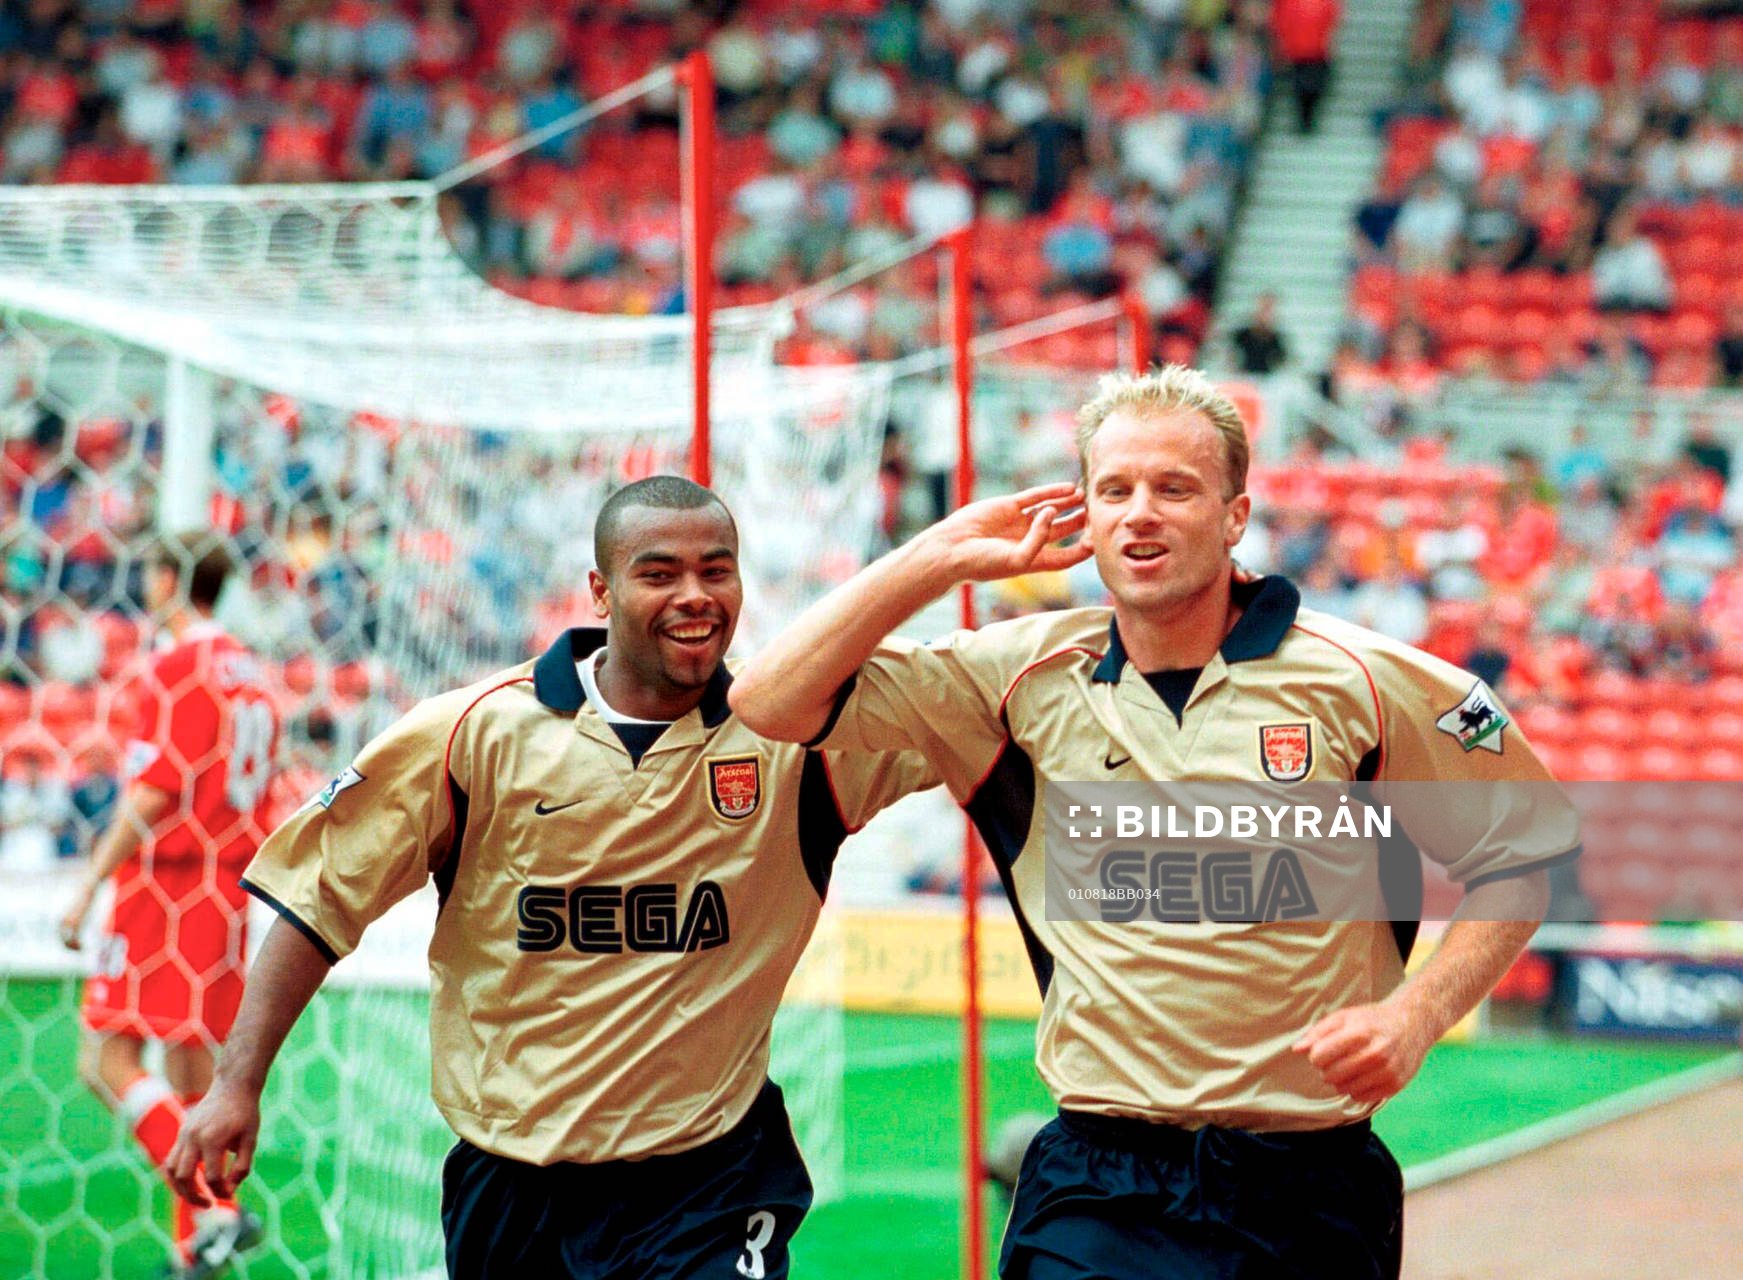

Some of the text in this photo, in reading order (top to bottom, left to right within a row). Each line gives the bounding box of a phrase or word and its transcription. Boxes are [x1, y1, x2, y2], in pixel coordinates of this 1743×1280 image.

[718, 765, 754, 779] Arsenal
[517, 880, 730, 954] SEGA
[1100, 849, 1319, 923] SEGA
[736, 1210, 776, 1280] 3
